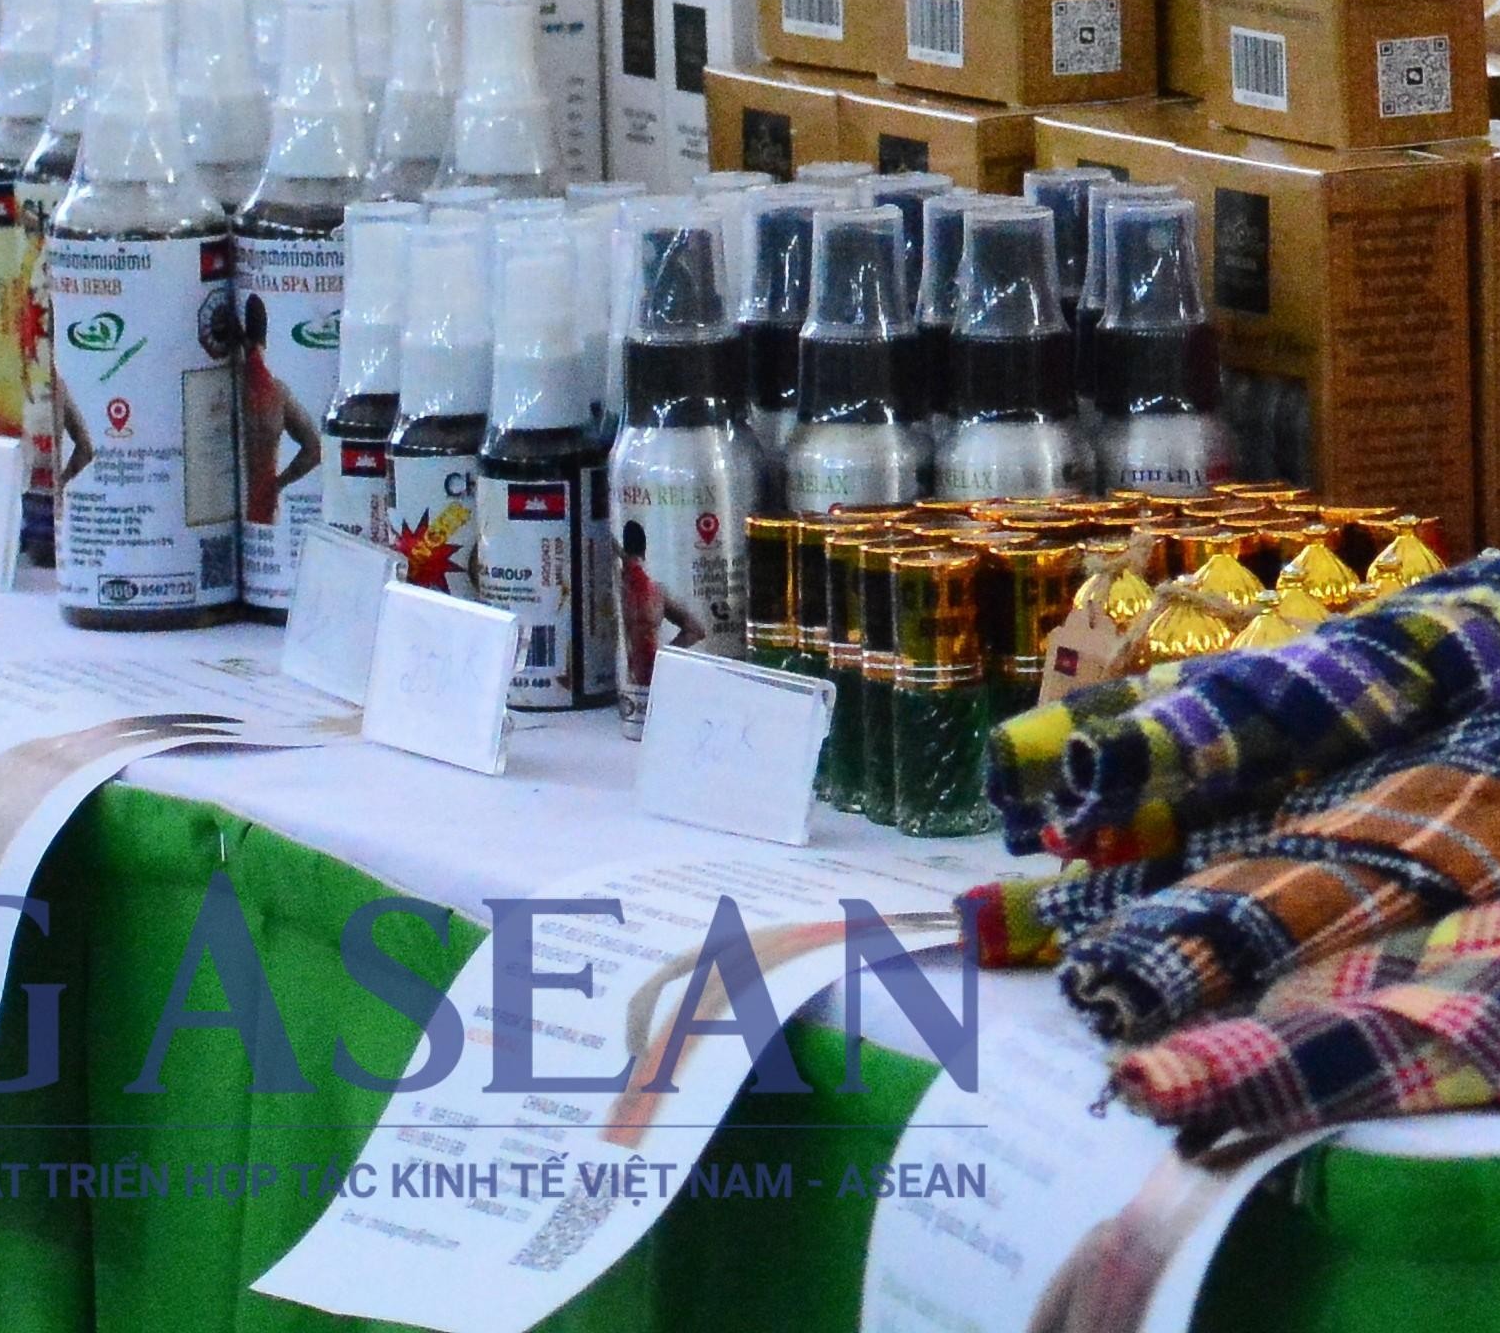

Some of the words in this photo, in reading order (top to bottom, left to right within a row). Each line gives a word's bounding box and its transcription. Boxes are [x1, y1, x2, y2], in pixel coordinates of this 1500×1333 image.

[281, 275, 310, 293] SPA
[623, 485, 652, 506] SPA
[491, 566, 533, 582] GROUP
